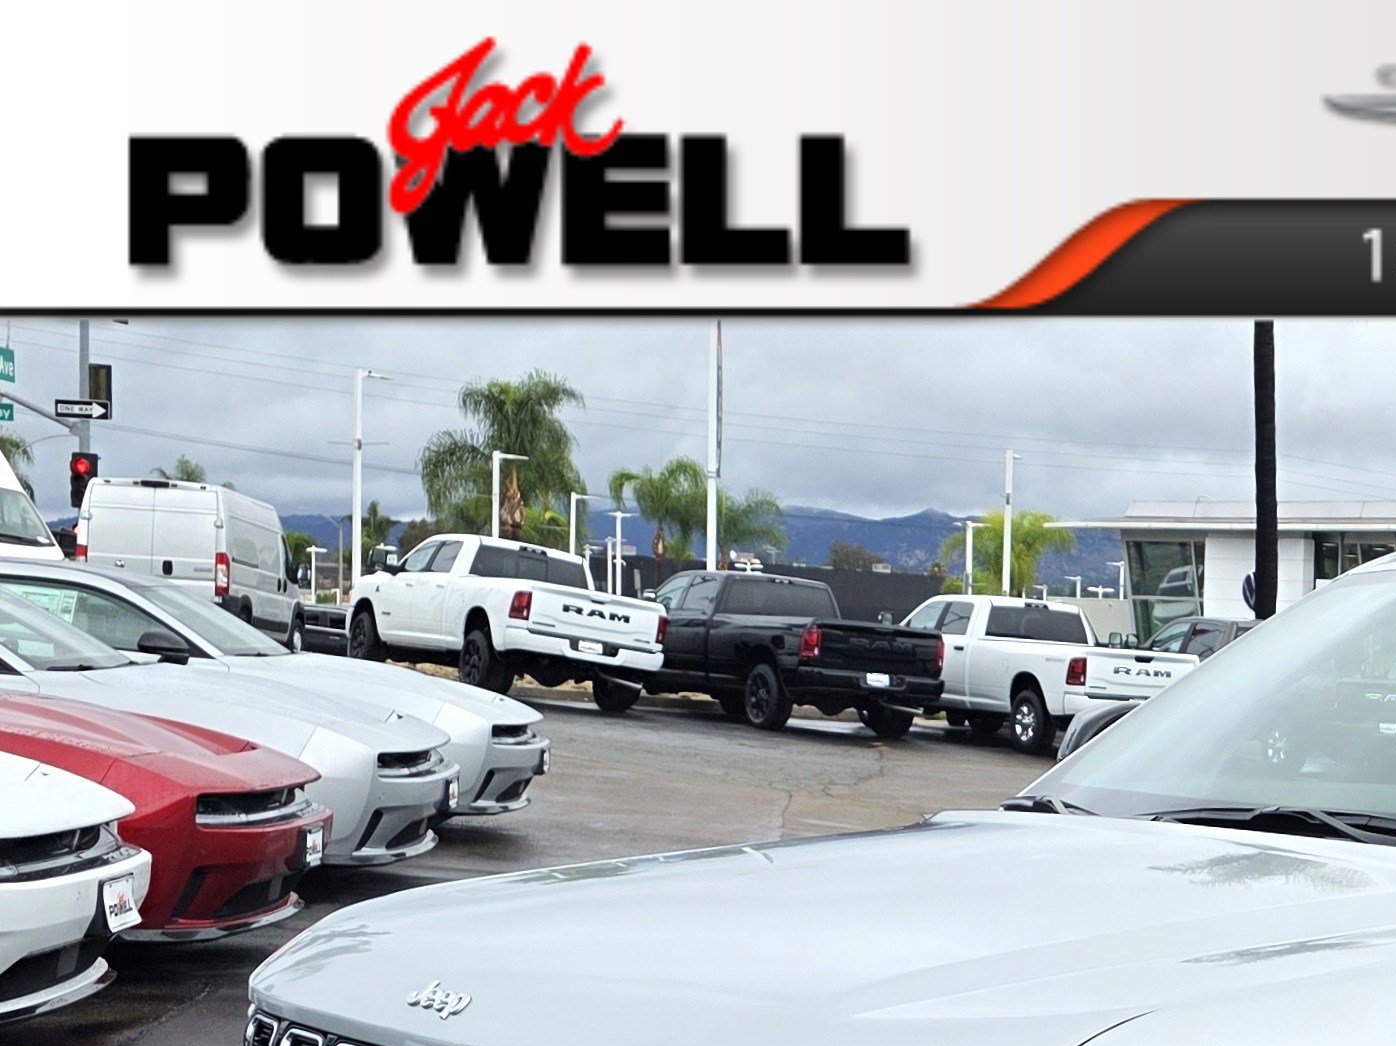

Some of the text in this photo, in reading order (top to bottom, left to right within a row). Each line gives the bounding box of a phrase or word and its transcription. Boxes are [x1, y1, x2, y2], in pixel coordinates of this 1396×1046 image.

[562, 603, 630, 624] RAM
[1113, 666, 1172, 678] RAM
[406, 979, 473, 1020] Jeep
